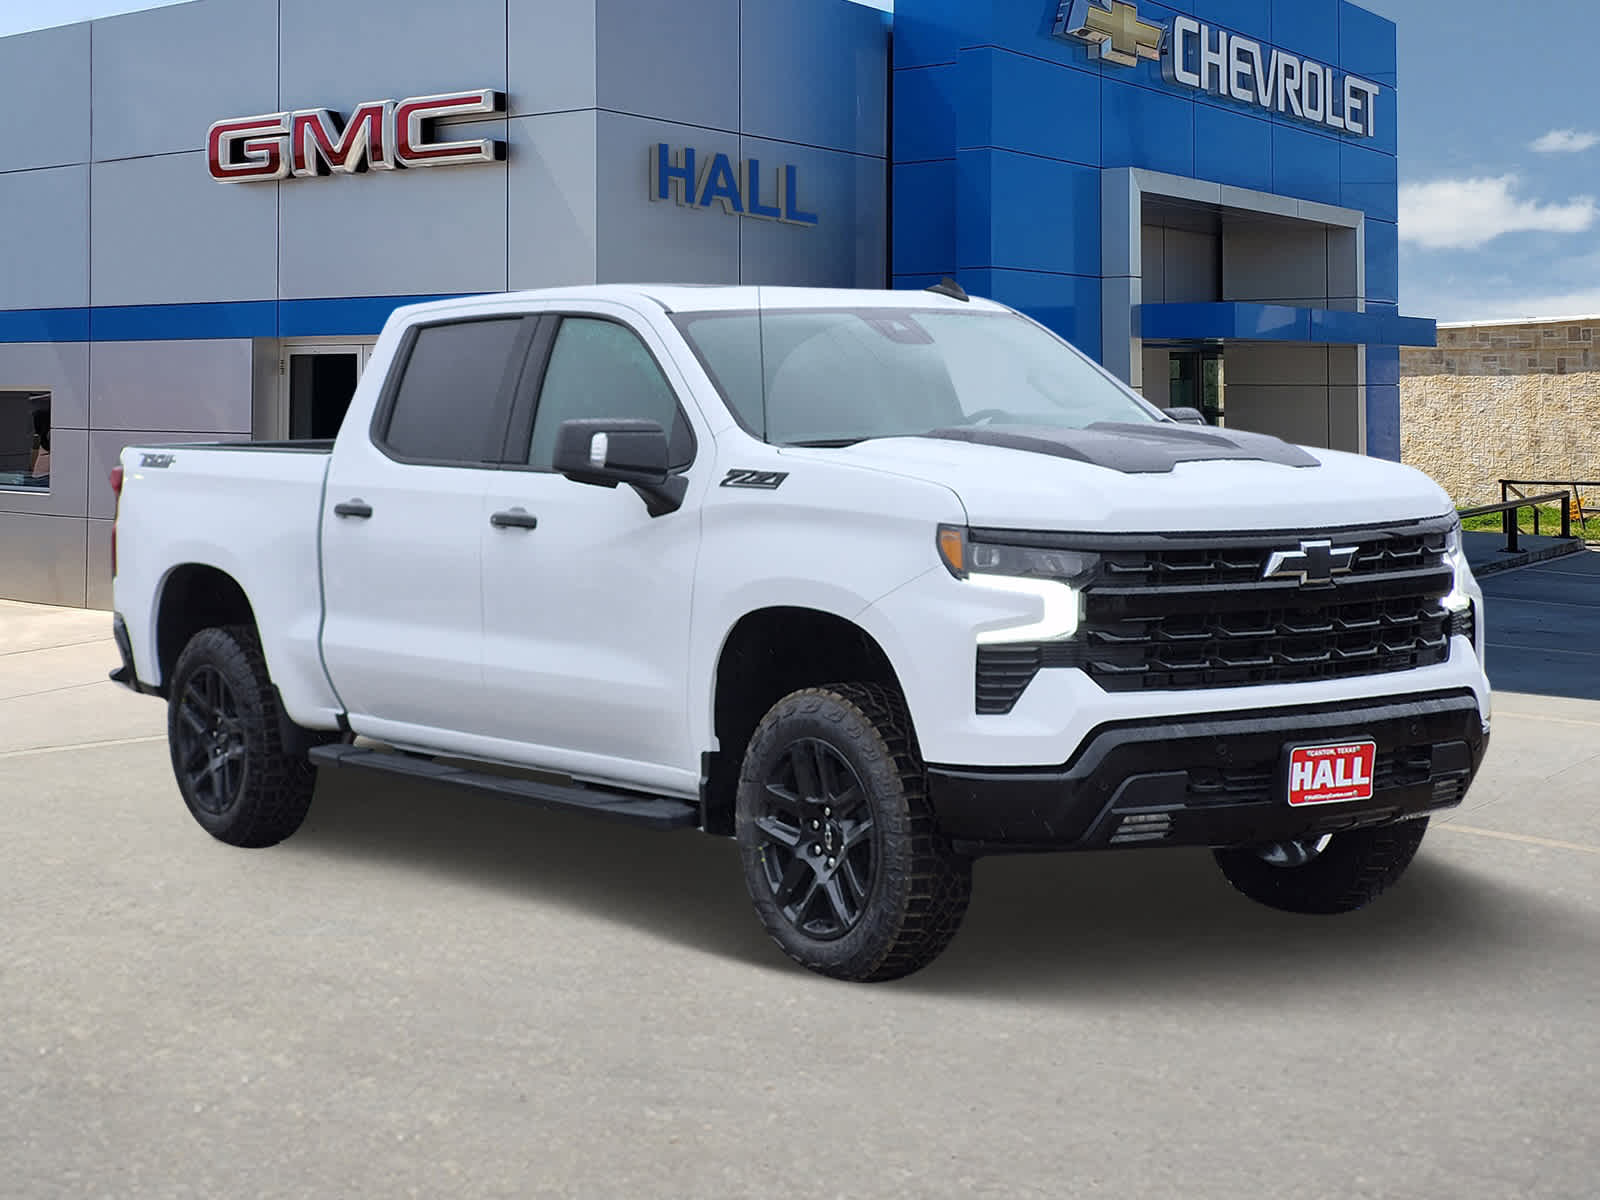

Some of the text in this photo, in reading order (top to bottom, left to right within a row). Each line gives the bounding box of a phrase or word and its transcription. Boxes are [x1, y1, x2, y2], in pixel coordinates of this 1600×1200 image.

[1173, 15, 1380, 138] CHEVROLET
[208, 88, 507, 184] GMC
[650, 143, 818, 227] HALL
[1291, 757, 1370, 791] HALL
